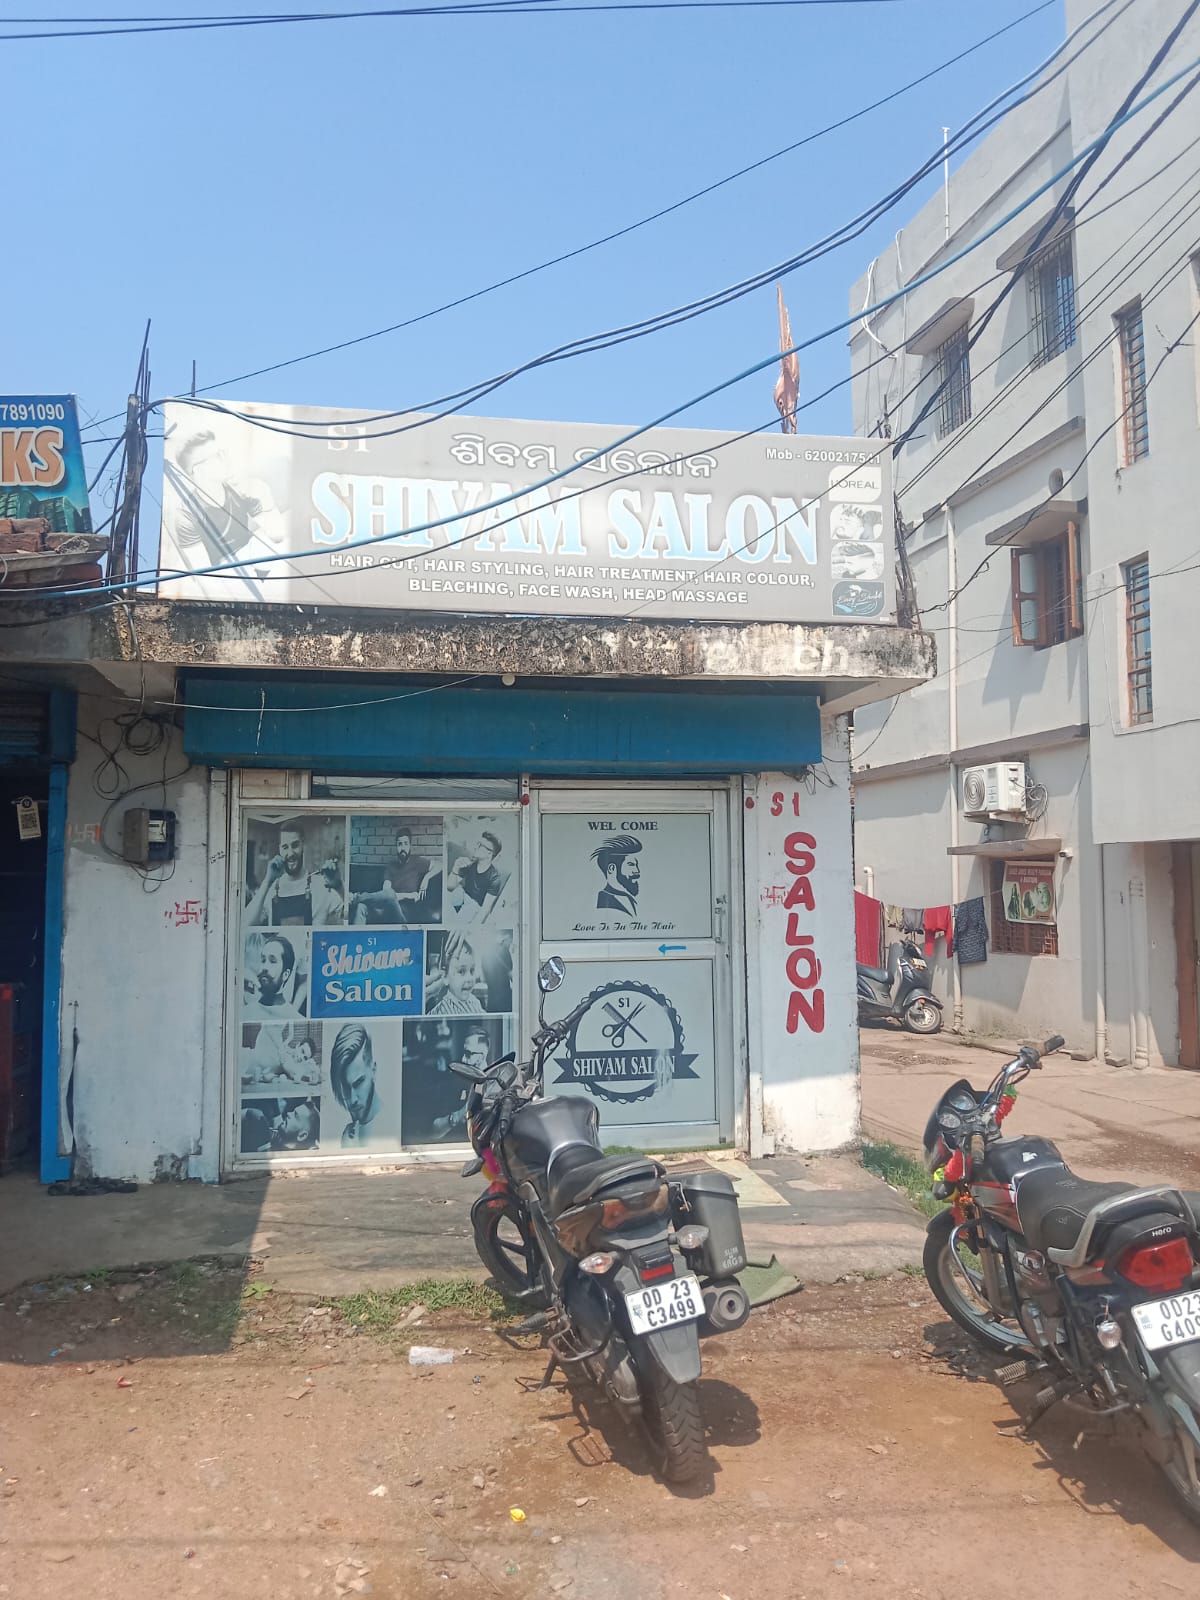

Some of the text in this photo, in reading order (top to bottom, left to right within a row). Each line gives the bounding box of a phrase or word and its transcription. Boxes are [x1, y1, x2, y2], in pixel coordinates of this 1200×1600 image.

[0, 403, 65, 421] 7891090
[0, 425, 65, 487] KS
[766, 447, 793, 460] Mob
[311, 471, 820, 565] SHIVAM SALON
[330, 554, 815, 588] HAIR CUT, HAIR STYLING, HAIR TREATMENT, HAIR COLOUR,
[409, 578, 748, 605] BLEACHING, FACE WASH, HEAD MASSAGE
[588, 821, 658, 831] WEL COME
[571, 922, 596, 932] Love
[630, 921, 648, 931] The
[783, 831, 825, 1034] SALON
[321, 944, 414, 977] Shivam
[325, 979, 412, 1003] Salon
[573, 1057, 627, 1077] SHIVAM
[670, 1280, 691, 1300] 23
[647, 1298, 696, 1327] C3499
